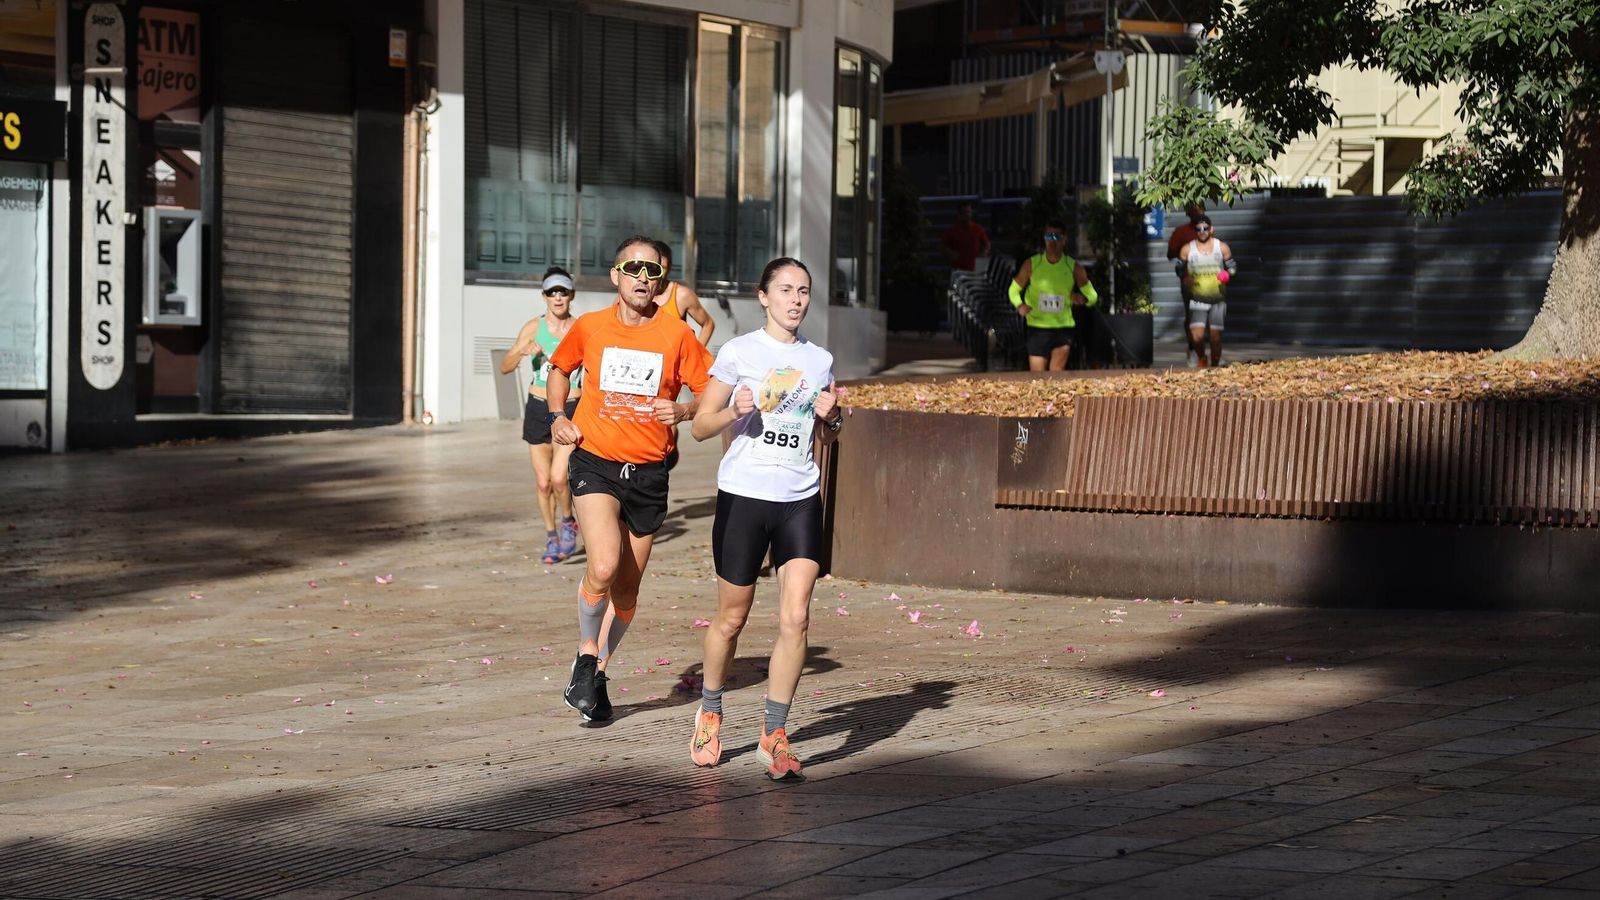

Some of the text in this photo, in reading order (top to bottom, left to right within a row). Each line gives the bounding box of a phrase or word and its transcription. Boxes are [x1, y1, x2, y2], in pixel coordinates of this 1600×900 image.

[92, 14, 116, 26] SHOP
[139, 17, 196, 56] ATM
[0, 111, 21, 150] S
[95, 38, 113, 346] SNEAKERS
[92, 355, 115, 365] SHOP
[775, 386, 803, 415] UATLON
[763, 430, 800, 449] 993
